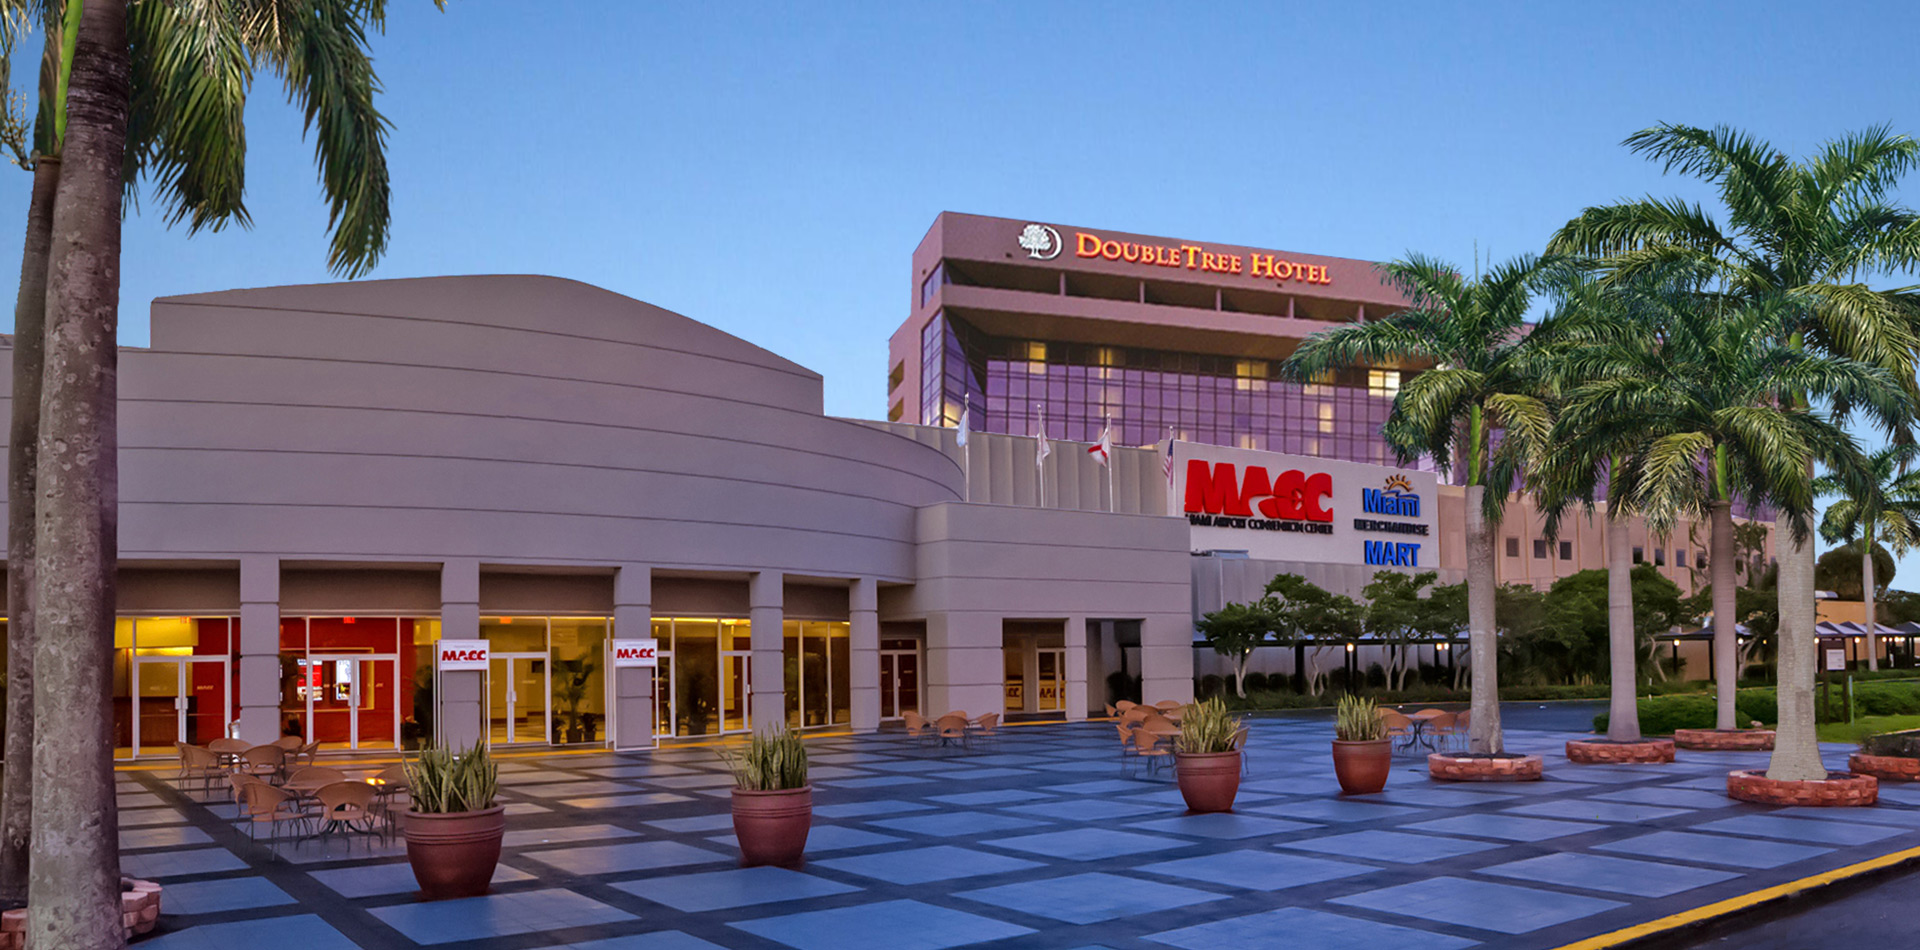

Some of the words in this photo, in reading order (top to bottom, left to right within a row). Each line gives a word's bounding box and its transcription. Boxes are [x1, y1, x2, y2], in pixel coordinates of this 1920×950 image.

[1184, 459, 1334, 523] MACC
[1362, 487, 1420, 517] Miami
[1304, 523, 1334, 534] CENTER
[1353, 518, 1429, 536] MERCHANDISE
[1364, 540, 1421, 567] MART
[441, 649, 487, 661] MACC
[616, 648, 655, 659] MACC
